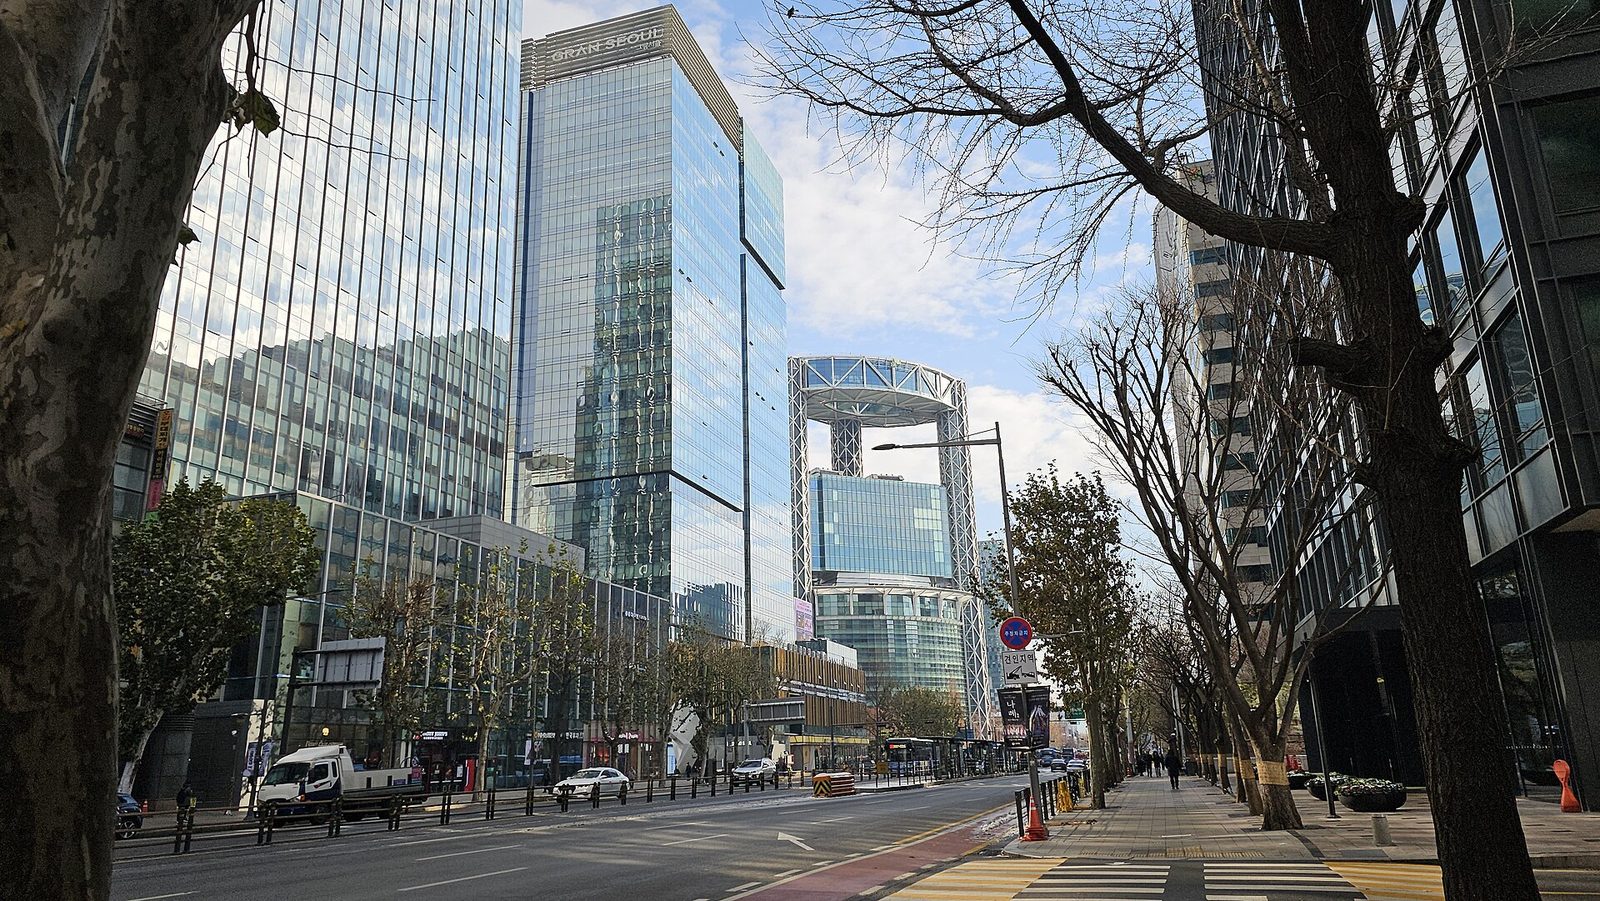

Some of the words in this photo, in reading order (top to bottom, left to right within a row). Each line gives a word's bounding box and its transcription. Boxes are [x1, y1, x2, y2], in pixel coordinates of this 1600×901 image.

[551, 43, 601, 62] GRAN
[604, 28, 663, 49] SEOUL
[1004, 653, 1034, 664] 견인지역
